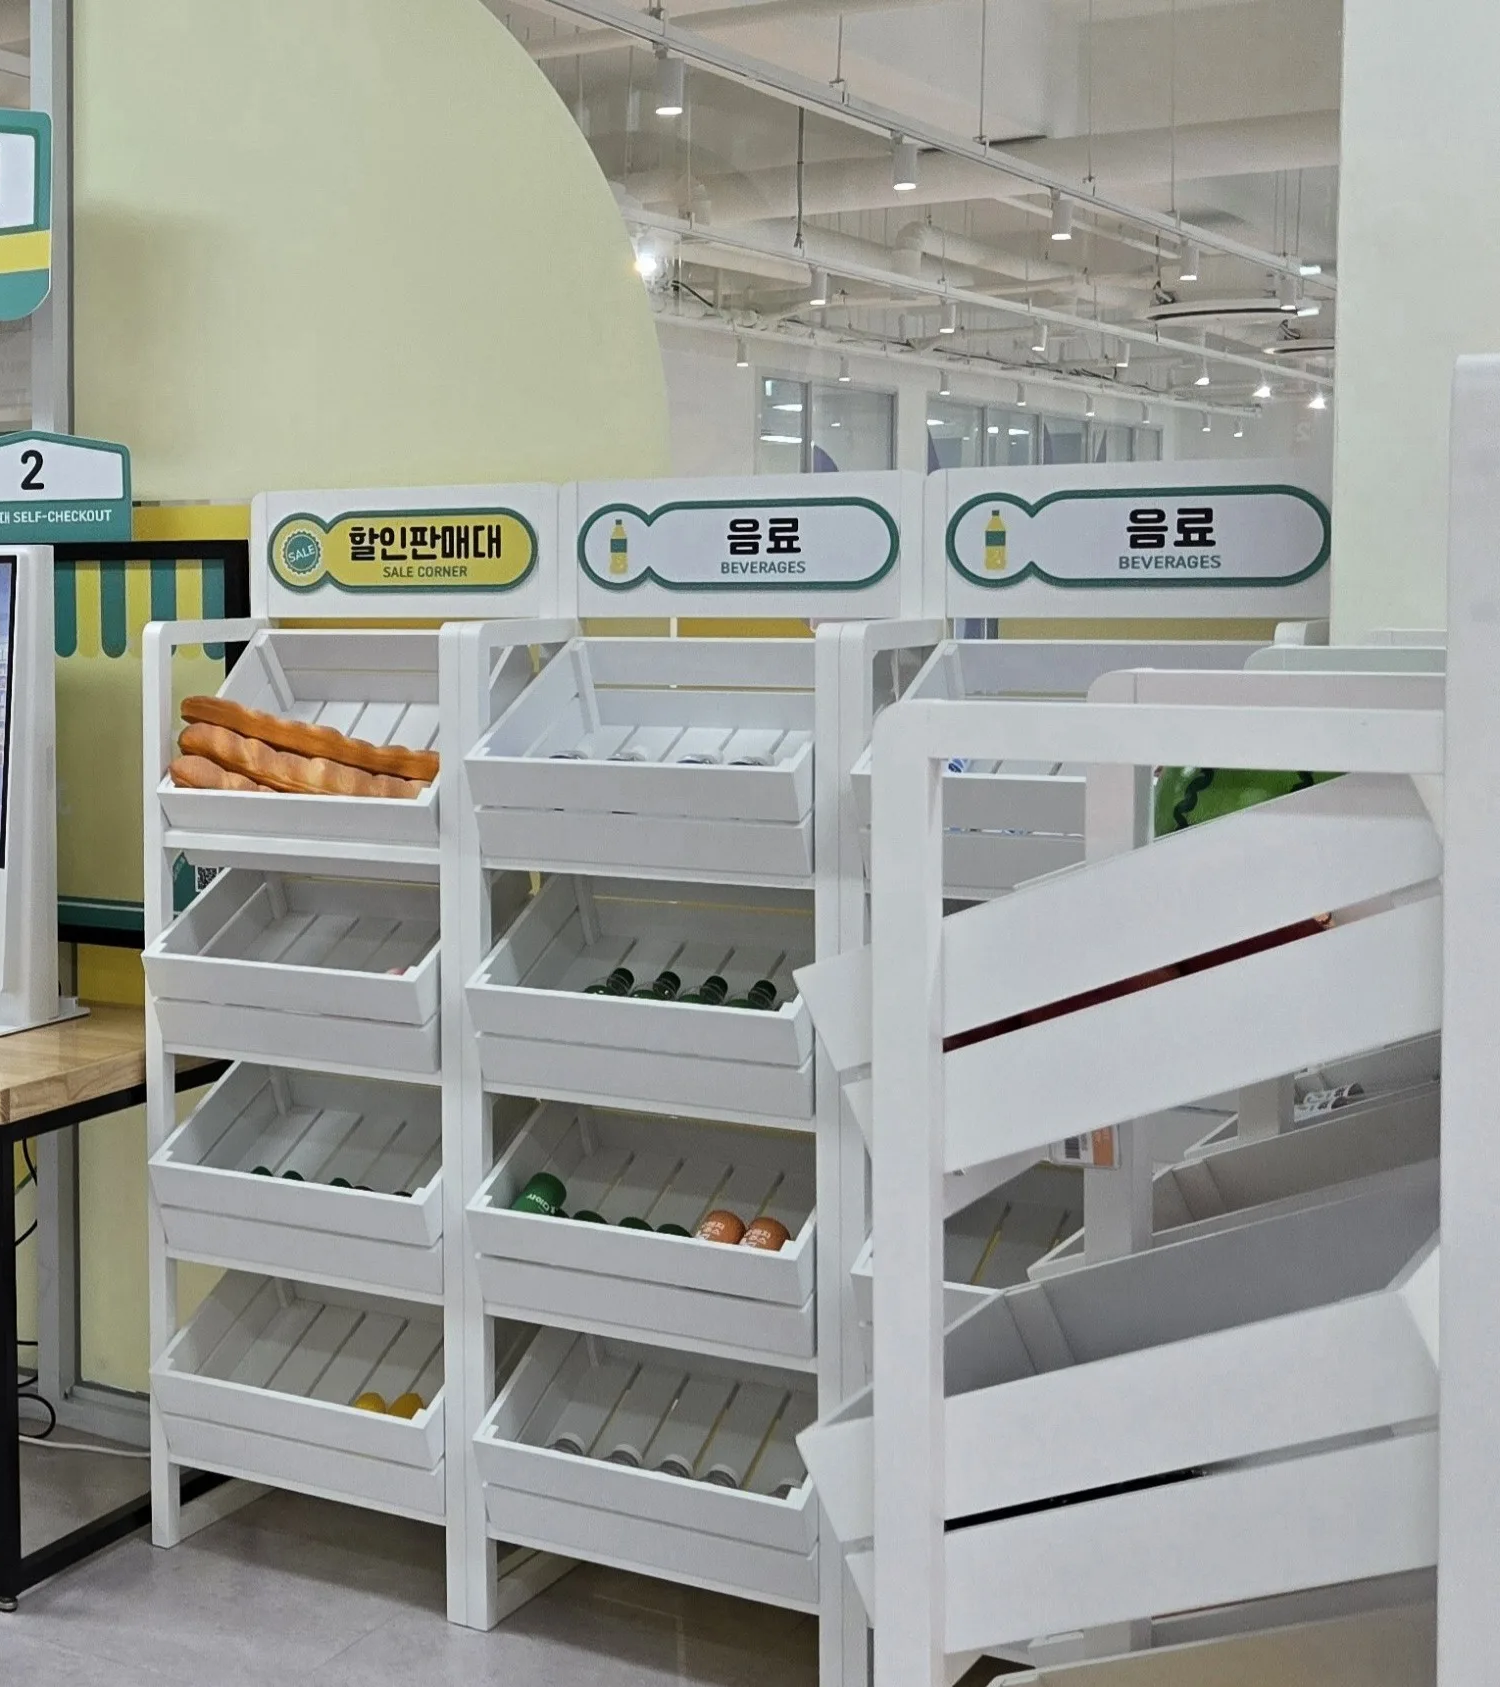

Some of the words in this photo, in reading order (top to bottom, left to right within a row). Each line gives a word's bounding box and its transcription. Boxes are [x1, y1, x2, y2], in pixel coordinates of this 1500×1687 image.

[21, 450, 44, 490] 2
[13, 509, 112, 523] SELF-CHECKOUT
[727, 517, 802, 555] 음료
[1126, 508, 1216, 549] 음료
[349, 524, 501, 561] 할인판매대
[287, 544, 316, 563] SALE
[1119, 555, 1222, 569] BEVERAGES
[383, 566, 414, 578] SALE
[417, 565, 468, 578] CORNER
[721, 561, 806, 574] BEVERAGES
